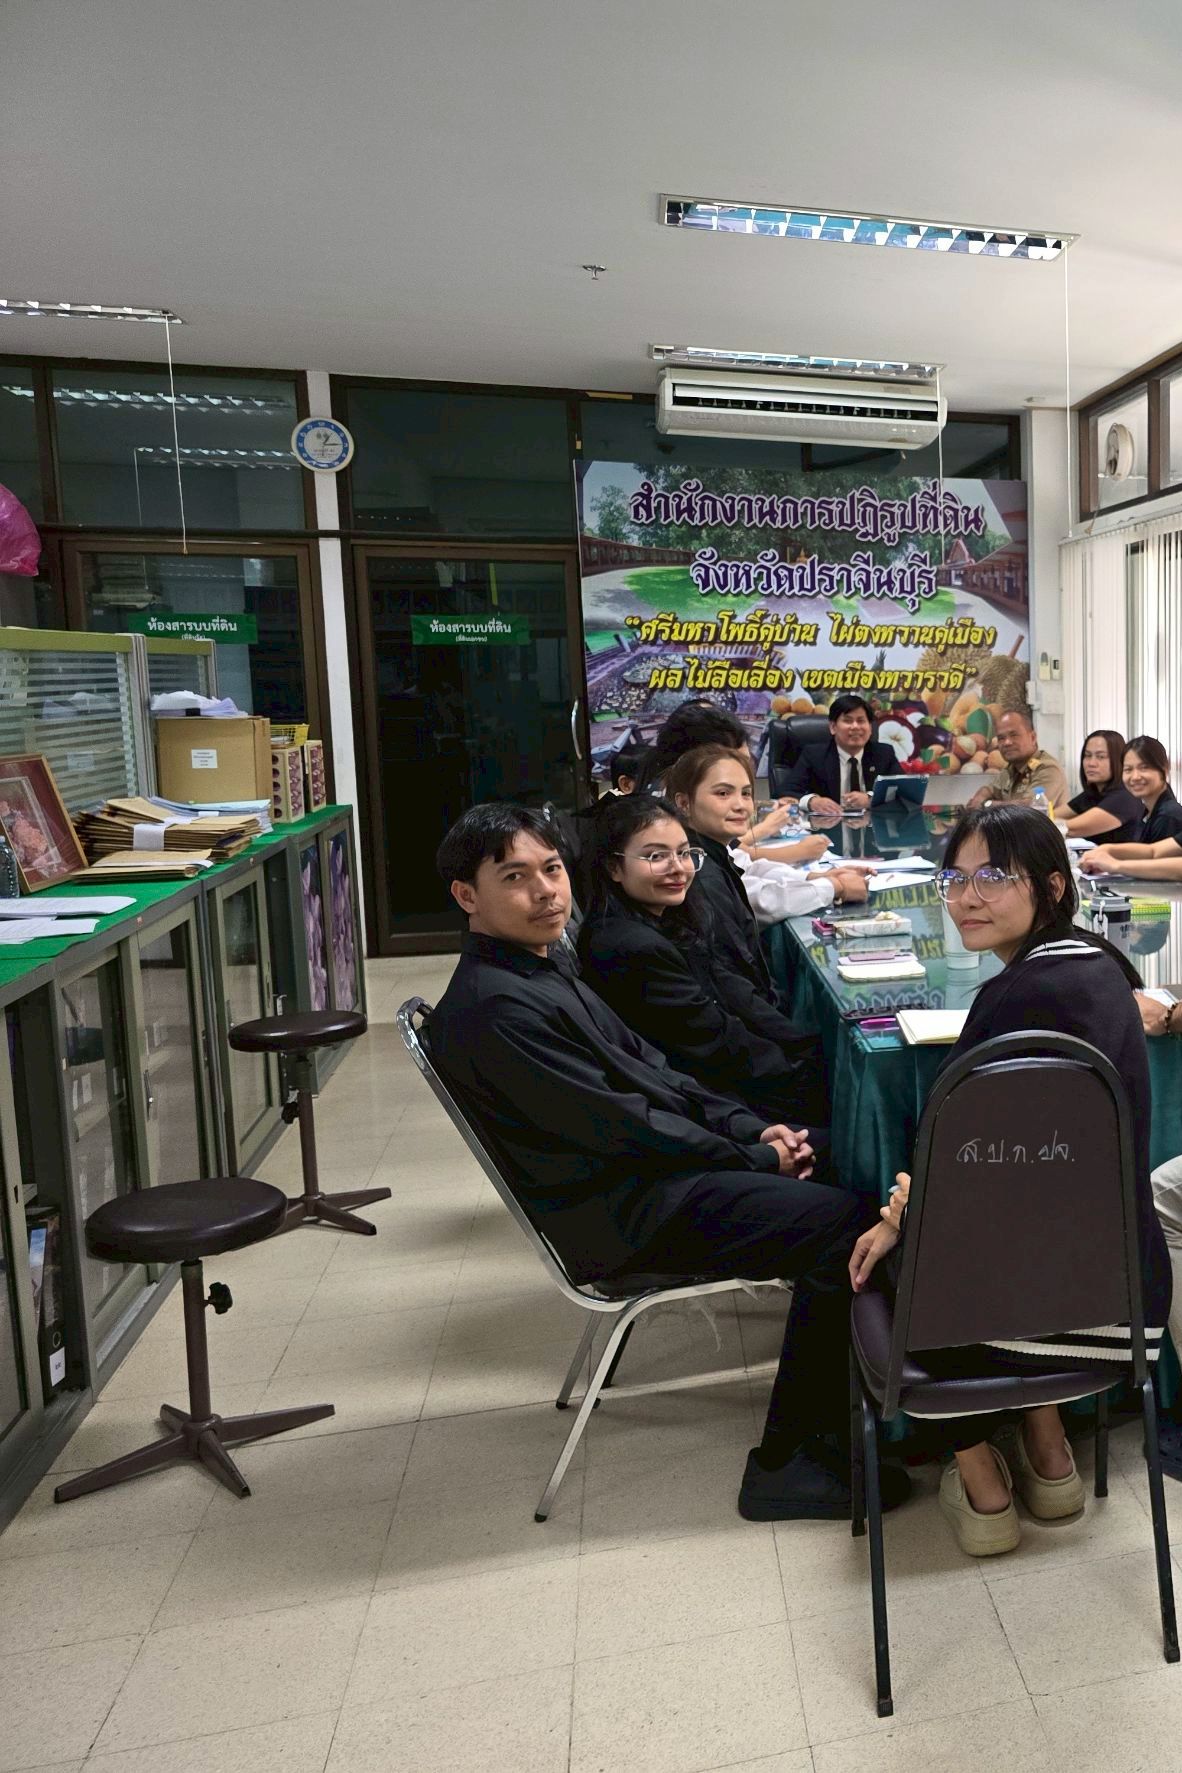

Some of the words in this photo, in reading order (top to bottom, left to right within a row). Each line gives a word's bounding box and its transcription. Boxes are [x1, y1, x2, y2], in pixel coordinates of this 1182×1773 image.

[630, 478, 984, 546] สำนักงานการปฏิรูปที่ดิน
[690, 547, 937, 613] จังหวัดปราจีนบุรี
[147, 615, 238, 632] ห้องสารบบที่ดิน
[429, 617, 512, 634] ห้องสารบบที่ดิน
[828, 611, 997, 653] ไผ่ตงหวานคู่เมือง
